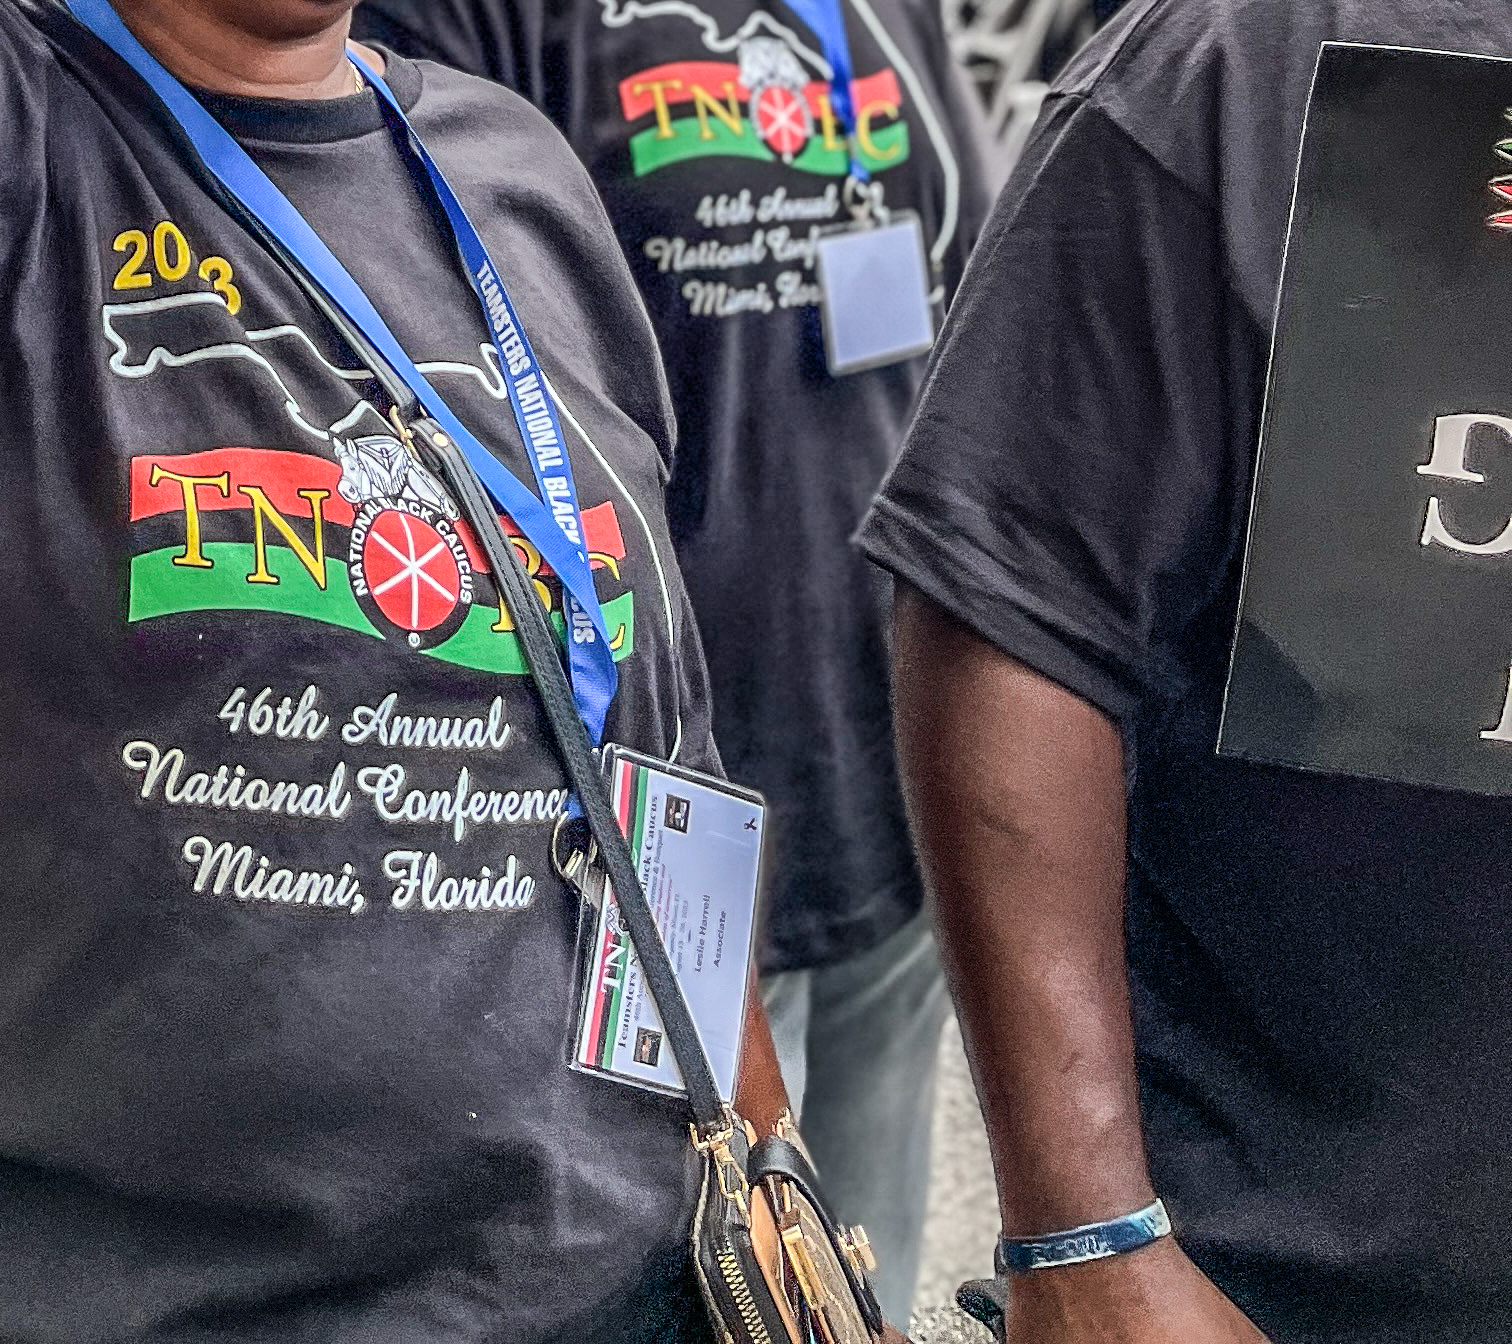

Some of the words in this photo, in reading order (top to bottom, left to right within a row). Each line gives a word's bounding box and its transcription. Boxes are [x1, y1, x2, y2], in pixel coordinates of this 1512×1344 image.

[633, 80, 745, 141] TN
[112, 220, 242, 316] 203
[644, 228, 767, 272] National
[766, 225, 821, 270] Conf
[476, 259, 531, 381] TEAMSTERS
[513, 371, 563, 473] NATIONAL
[149, 464, 332, 591] TN
[350, 499, 382, 597] NATIONAL
[435, 519, 473, 604] CAUCUS
[218, 685, 329, 740] 46th
[342, 692, 510, 748] Annual
[122, 740, 350, 819] National
[644, 795, 659, 851] Caucus
[183, 835, 365, 914] Miami,
[384, 848, 536, 911] Florida
[640, 855, 652, 891] lack
[699, 894, 712, 937] Harrell
[713, 910, 727, 968] Associate
[601, 942, 627, 993] TN
[694, 939, 705, 973] Leslie
[617, 970, 637, 1048] Teamsters
